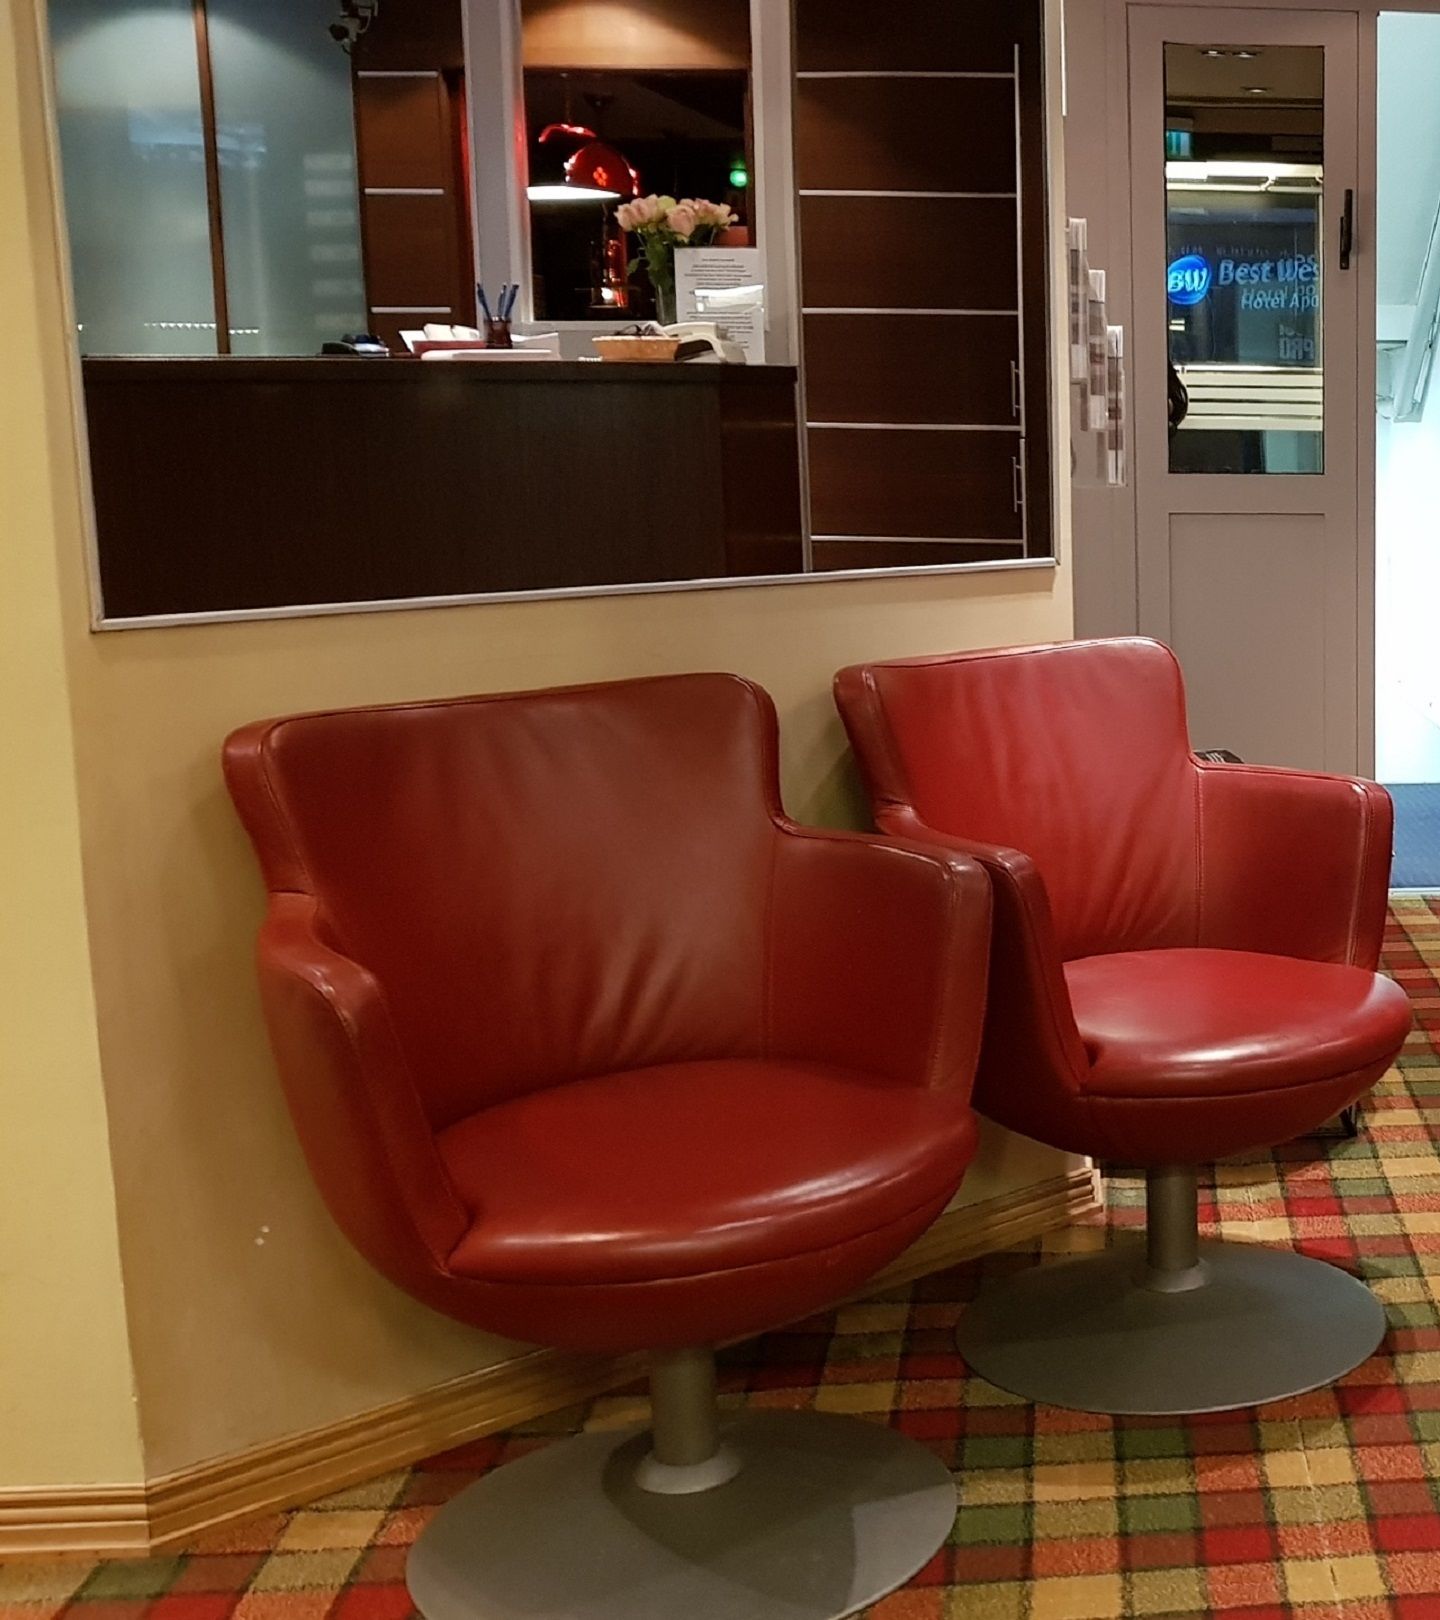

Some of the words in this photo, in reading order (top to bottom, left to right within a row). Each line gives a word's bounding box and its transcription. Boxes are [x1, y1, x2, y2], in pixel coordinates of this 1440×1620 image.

[1168, 267, 1208, 292] BW
[1219, 259, 1274, 285] Best
[1241, 294, 1285, 310] Hotel
